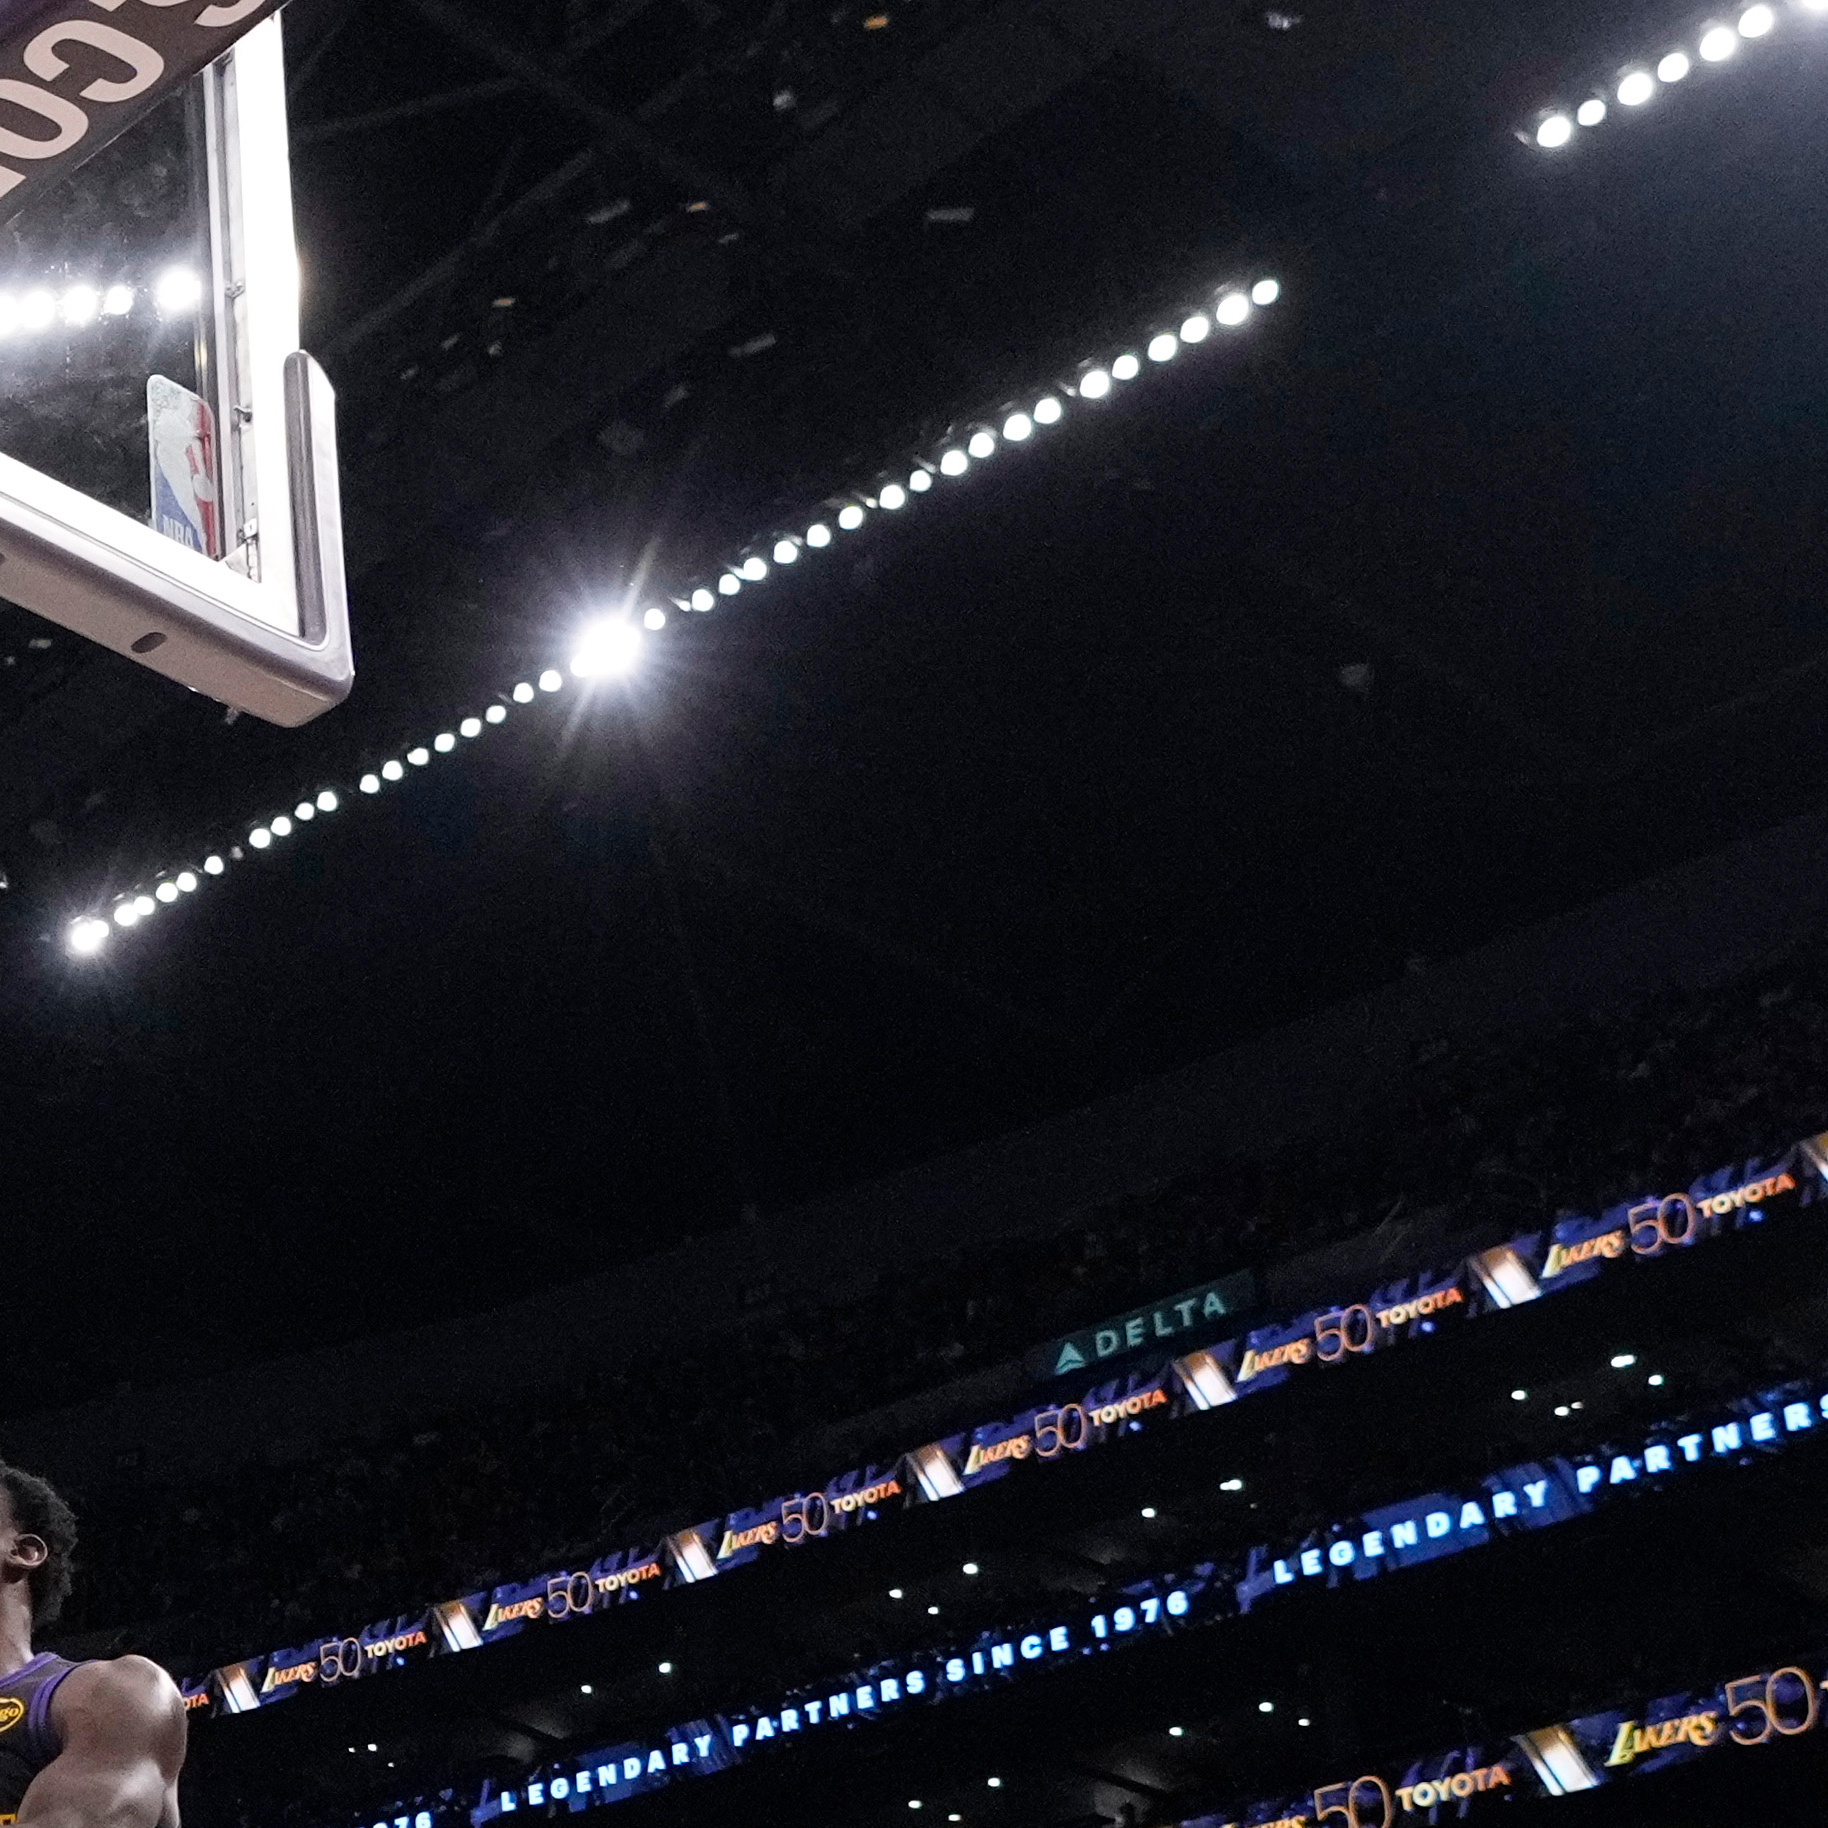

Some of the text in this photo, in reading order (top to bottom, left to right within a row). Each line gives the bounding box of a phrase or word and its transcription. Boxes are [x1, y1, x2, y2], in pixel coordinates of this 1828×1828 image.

[1627, 1192, 1696, 1254] 50
[1696, 1172, 1796, 1219] TOYOTA
[1094, 1291, 1226, 1357] DELTA
[1314, 1304, 1374, 1361] 50
[1377, 1287, 1465, 1328] TOYOTA
[1033, 1403, 1088, 1457] 50
[1089, 1387, 1167, 1427] TOYOTA
[780, 1492, 832, 1543] 50
[830, 1478, 902, 1513] TOYOTA
[1272, 1479, 1547, 1583] LEGENDARY
[546, 1571, 593, 1618] 50
[595, 1562, 660, 1594] TOYOTA
[319, 1637, 362, 1683] 50
[364, 1631, 427, 1659] TOYOTA
[500, 1590, 1190, 1812] LEGENDARY PARTNERS SINCE 1976
[1603, 1665, 1818, 1767] LAKERS 50
[1393, 1763, 1512, 1810] TOYOTA
